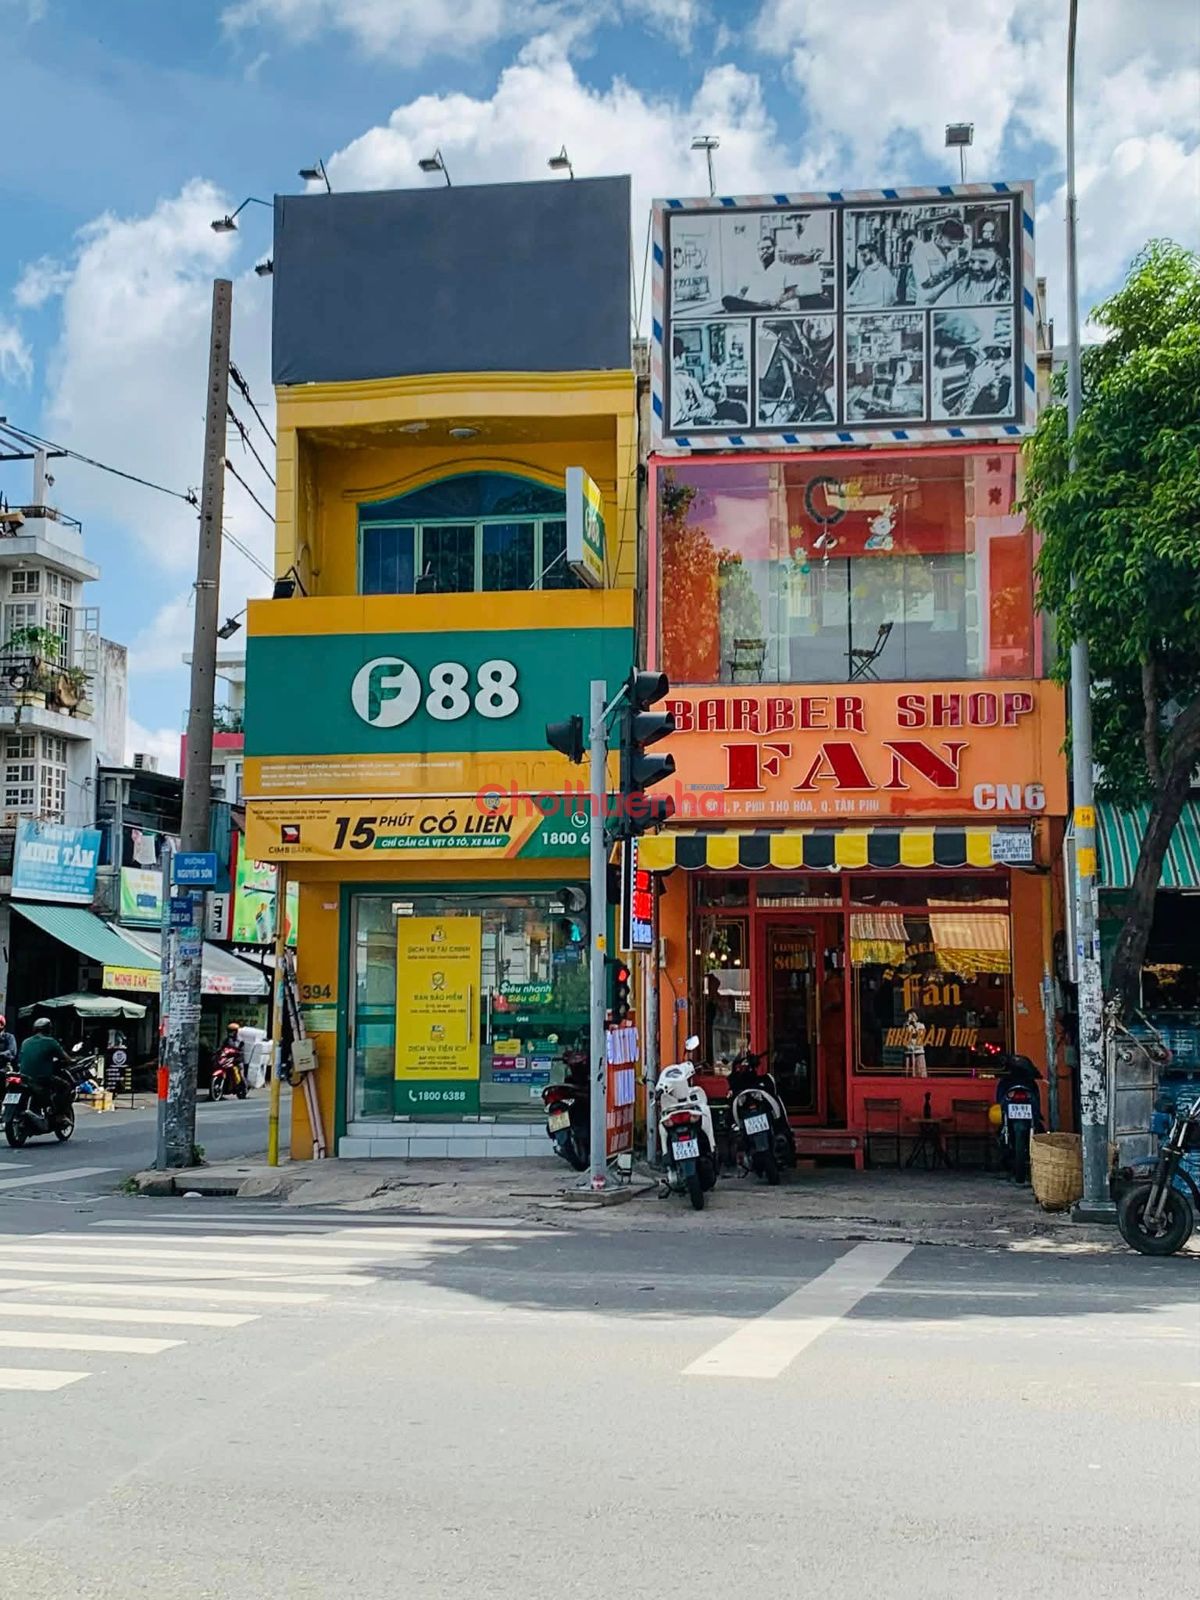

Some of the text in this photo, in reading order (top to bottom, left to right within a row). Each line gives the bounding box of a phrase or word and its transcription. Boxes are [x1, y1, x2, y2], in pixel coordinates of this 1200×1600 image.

[351, 657, 520, 727] F88
[665, 690, 1033, 736] BARBER SHOP
[721, 740, 969, 792] FAN
[972, 783, 1046, 811] CN6
[334, 816, 378, 850] 15
[379, 812, 415, 827] PHÚT
[419, 810, 457, 834] CÓ
[542, 832, 577, 845] 1800
[303, 985, 332, 1000] 394
[418, 1091, 466, 1102] 1800 6388
